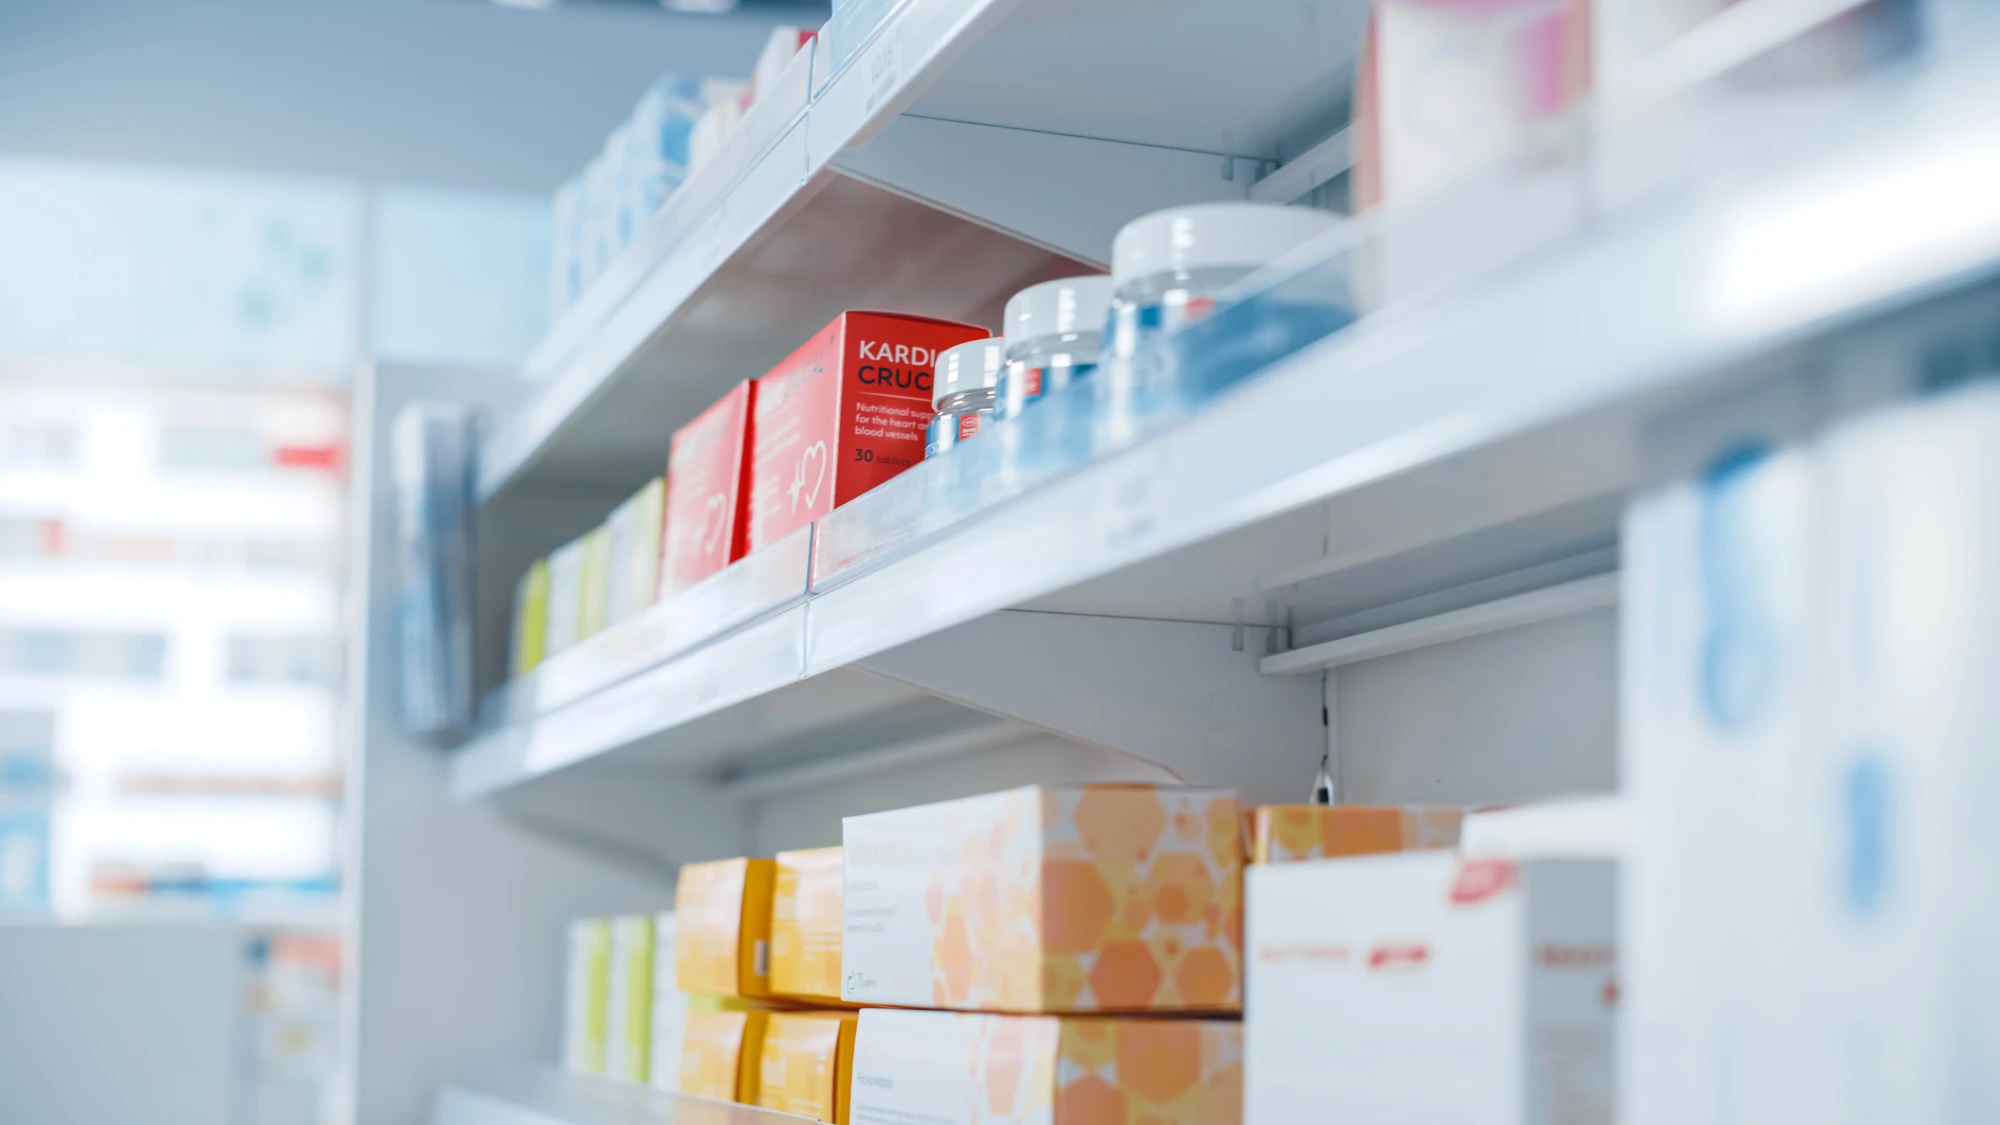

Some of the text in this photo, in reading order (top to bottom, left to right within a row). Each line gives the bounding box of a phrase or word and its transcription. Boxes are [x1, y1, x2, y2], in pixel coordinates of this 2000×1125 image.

[860, 340, 936, 368] KARDI
[858, 365, 931, 391] CRUC
[856, 402, 910, 417] Nutritional
[855, 413, 870, 424] for
[872, 414, 888, 426] the
[890, 417, 916, 429] heart
[854, 425, 919, 441] blood vessels
[854, 448, 874, 463] 30
